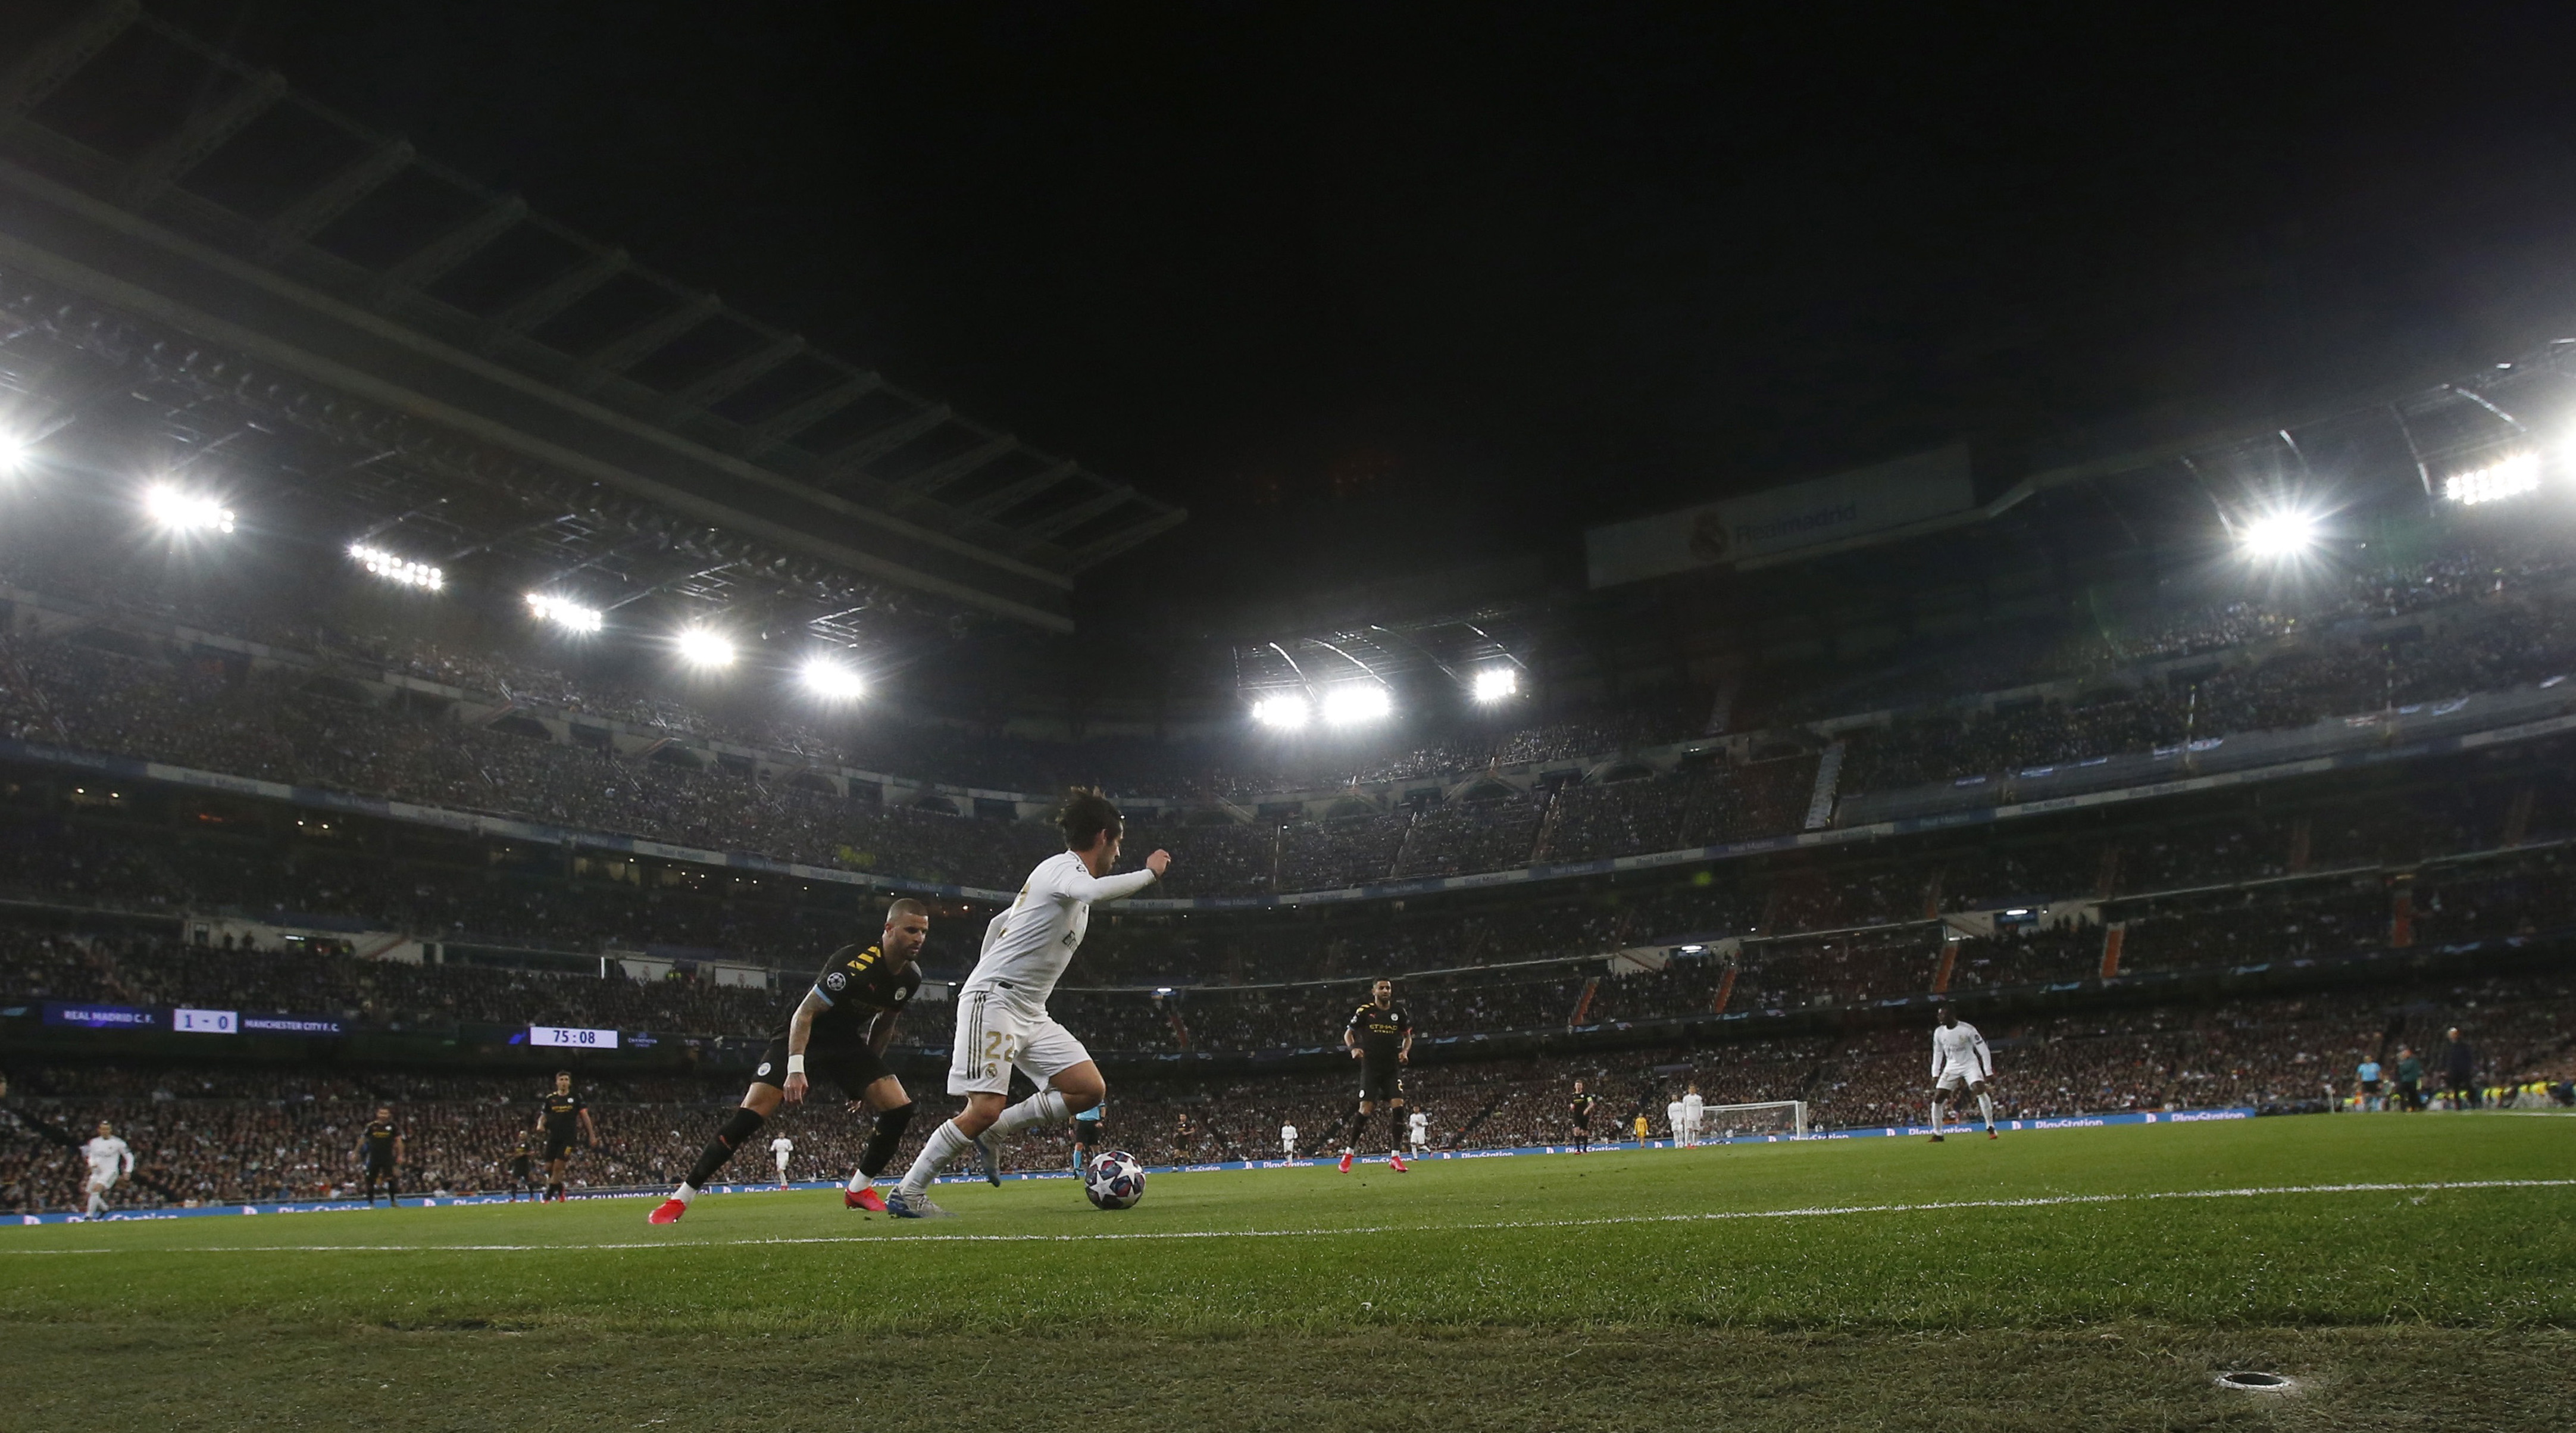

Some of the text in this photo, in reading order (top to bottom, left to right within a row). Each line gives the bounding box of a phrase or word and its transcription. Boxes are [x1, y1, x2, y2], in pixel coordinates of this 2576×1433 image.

[64, 1010, 90, 1020] REAL
[92, 1012, 133, 1022] MADRID
[185, 1015, 193, 1028] 1
[219, 1016, 228, 1029] 0
[245, 1019, 302, 1030] MANCHESTER
[303, 1022, 322, 1031] CITY
[985, 1031, 1014, 1063] 22
[2171, 1112, 2246, 1122] PlayStation
[2035, 1119, 2103, 1129] PlayStation
[1908, 1126, 1972, 1135] Playation
